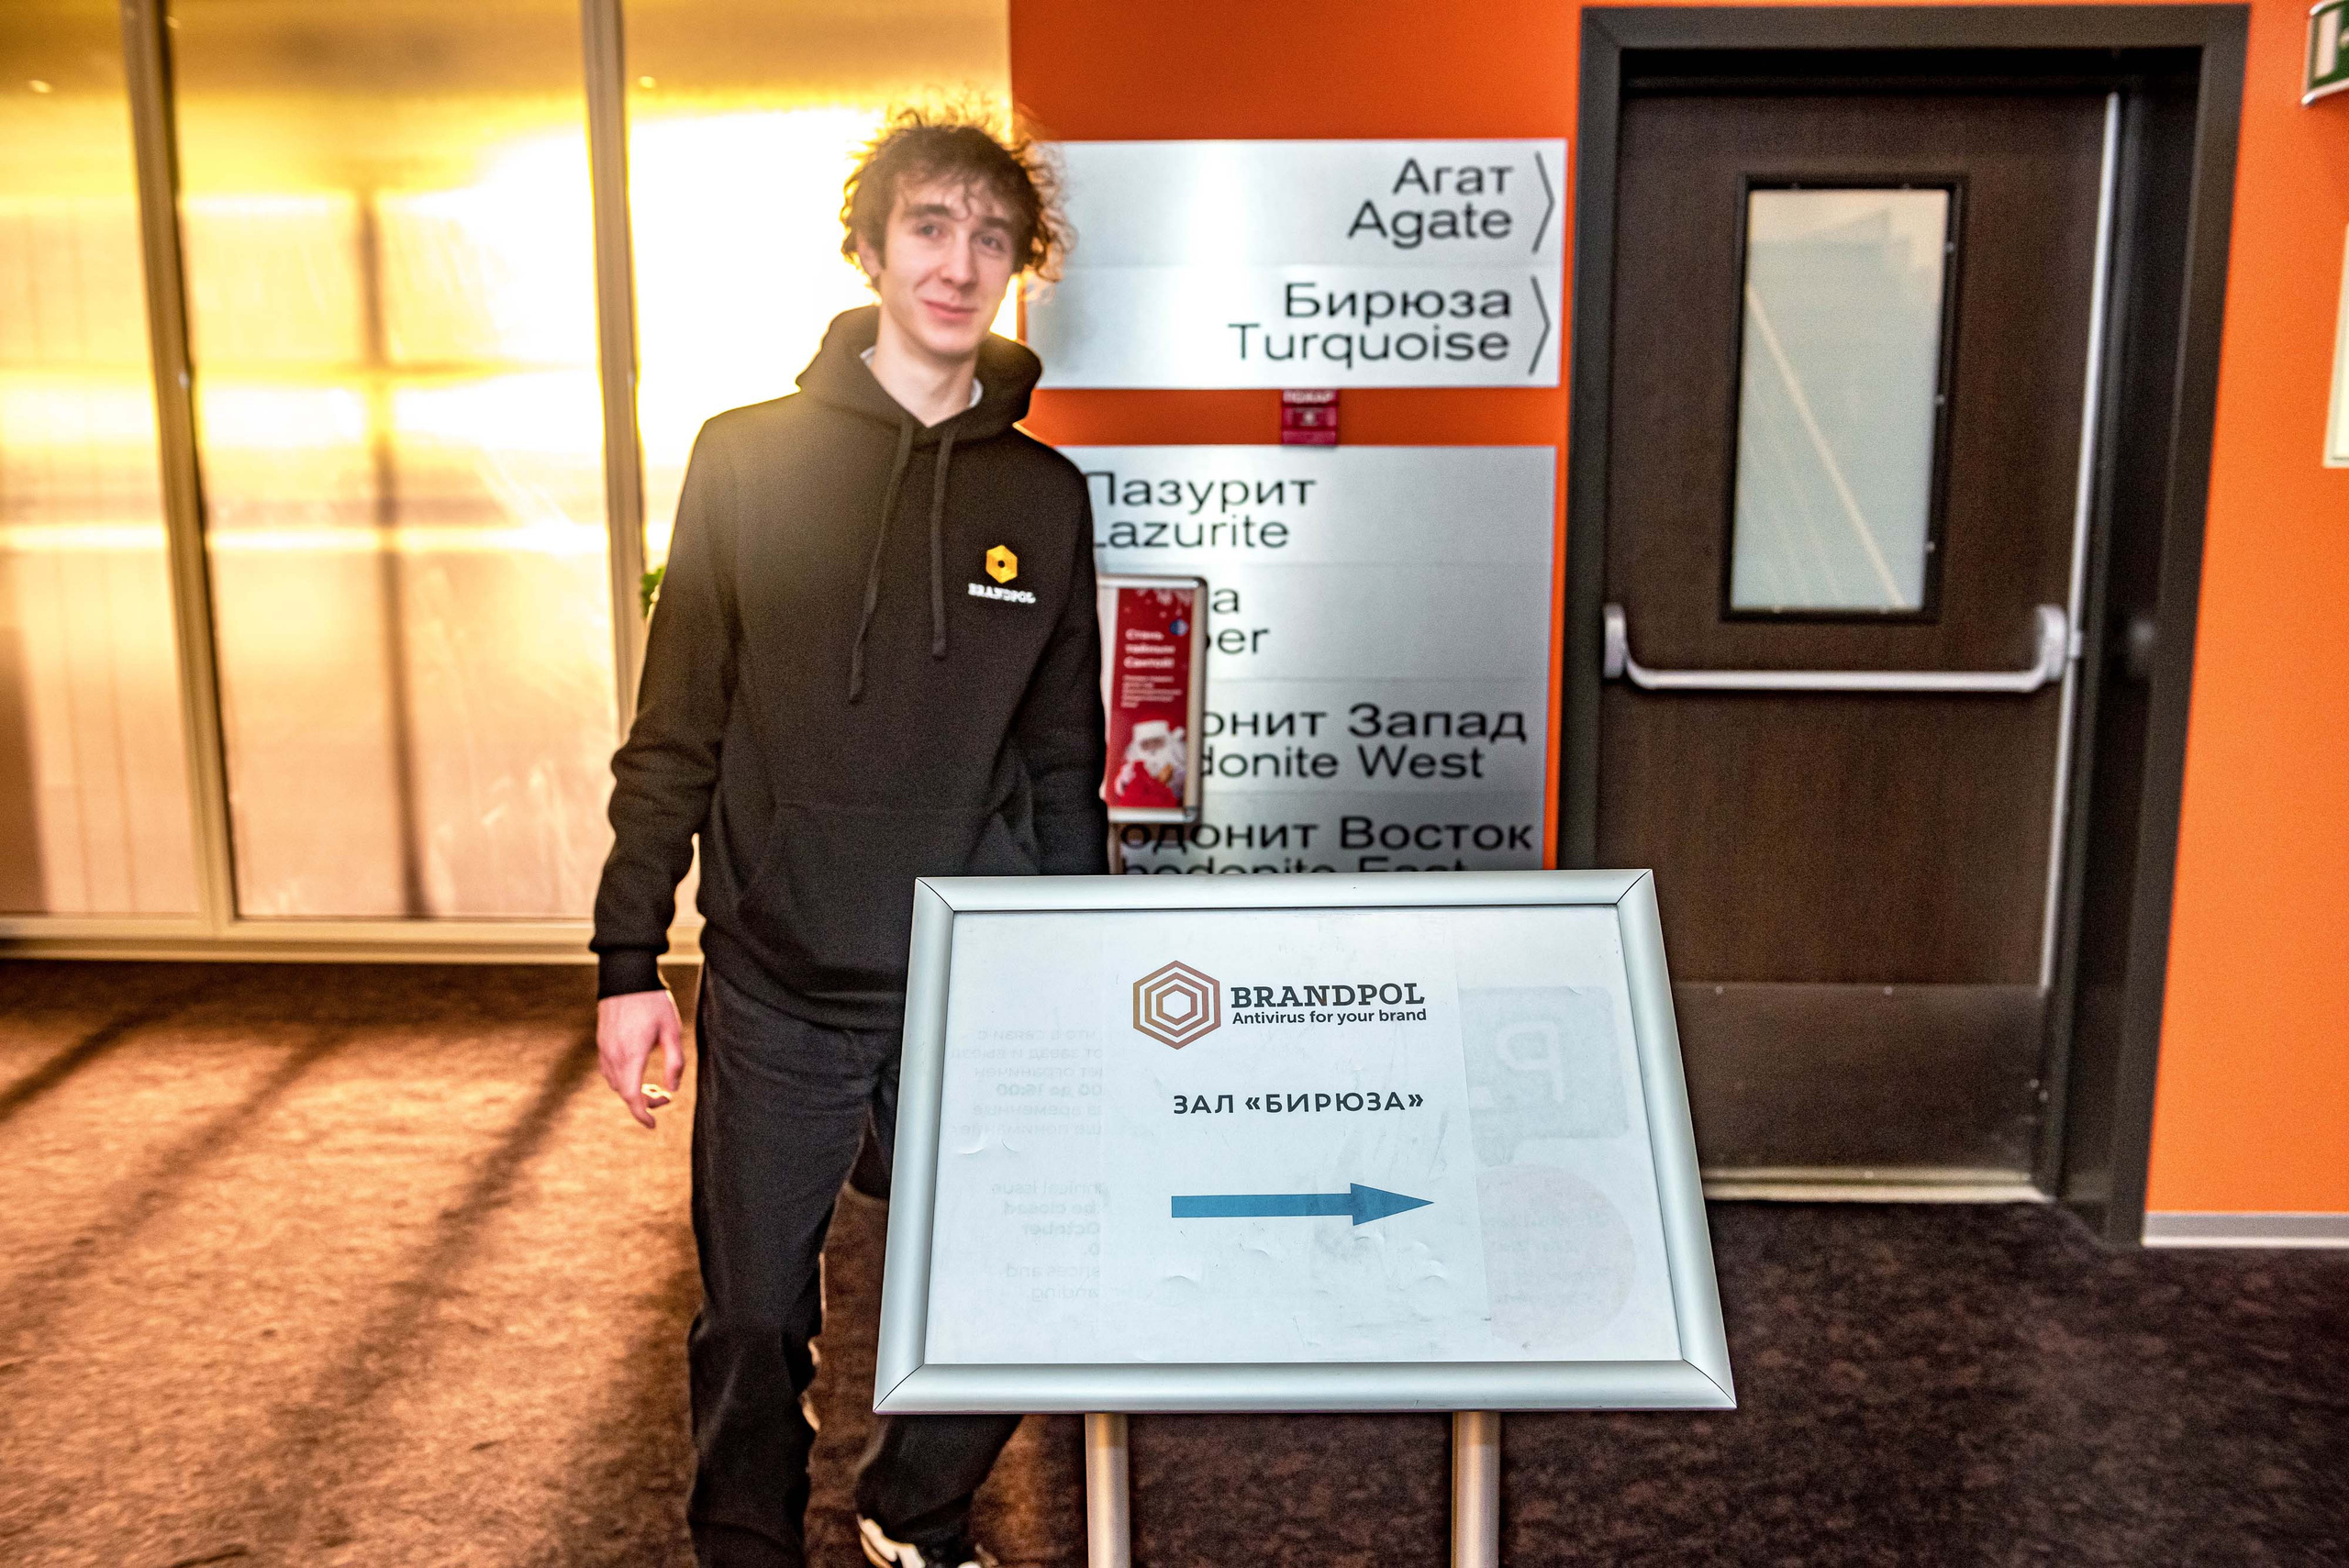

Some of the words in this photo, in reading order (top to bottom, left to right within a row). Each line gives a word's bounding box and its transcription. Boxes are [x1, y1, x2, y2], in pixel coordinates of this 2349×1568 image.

[1392, 158, 1513, 195] Агат
[1347, 200, 1512, 250] Agate
[1285, 282, 1511, 327] Бирюза
[1228, 324, 1510, 370] Turquoise
[1095, 515, 1289, 550] azurite
[1203, 711, 1328, 739] онит
[1348, 703, 1527, 744] Запад
[1201, 745, 1341, 779] donite
[1358, 744, 1485, 779] West
[1120, 823, 1319, 854] одонит
[1340, 816, 1531, 851] Восток
[1230, 983, 1426, 1008] BRANDPOL
[1232, 1011, 1306, 1025] Antivirus
[1309, 1010, 1334, 1023] for
[1336, 1011, 1375, 1026] your
[1378, 1008, 1427, 1023] brand
[1174, 1095, 1234, 1115] ЗАЛ
[1244, 1091, 1424, 1114] «БИРЮЗА»
